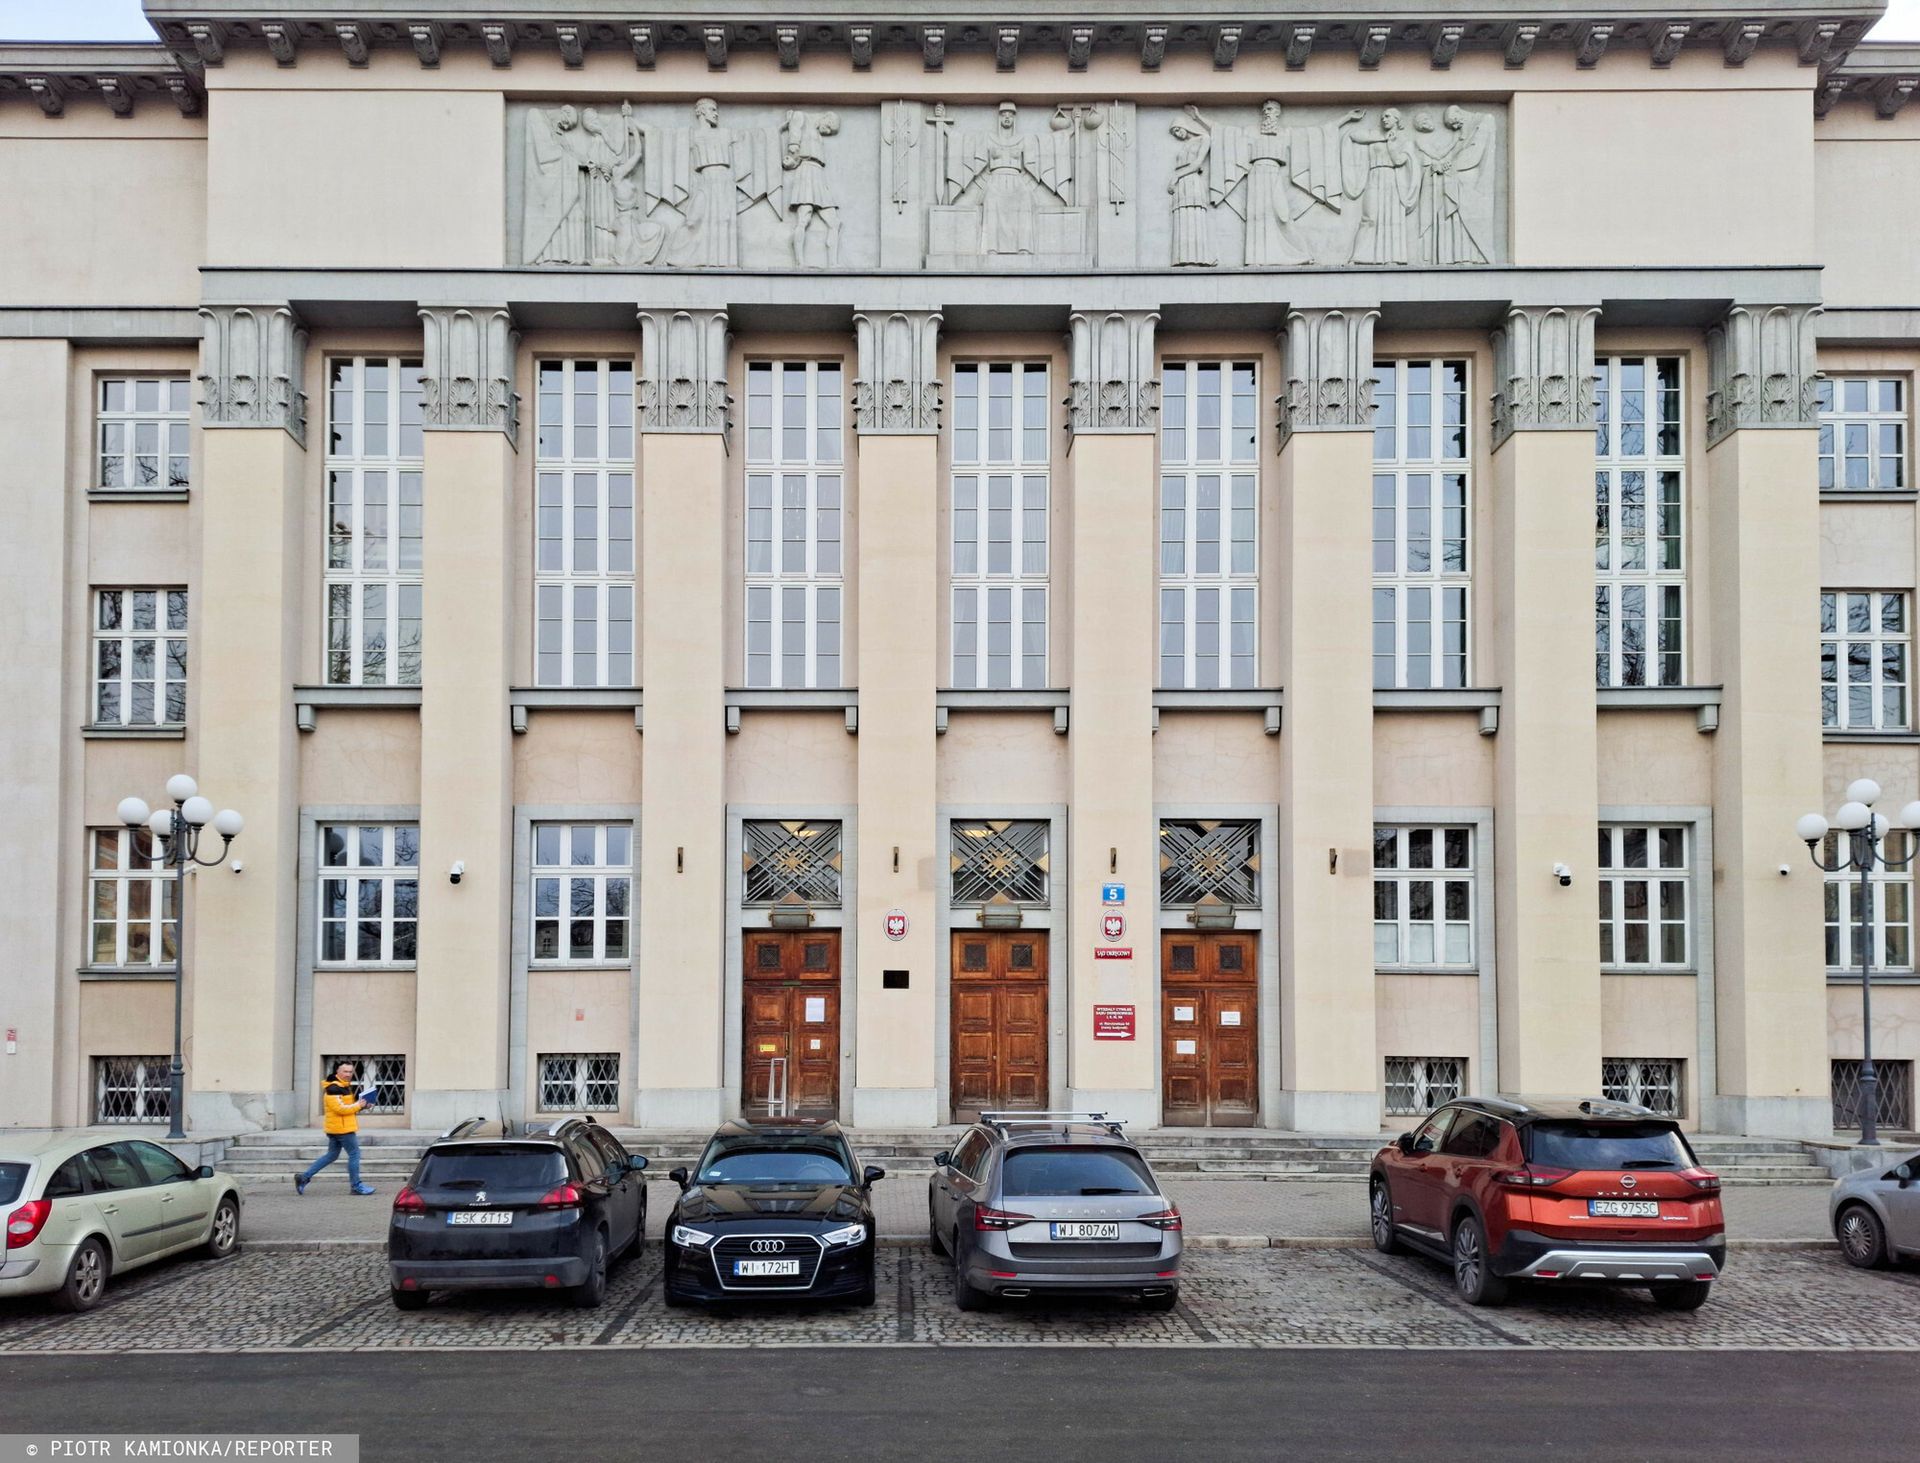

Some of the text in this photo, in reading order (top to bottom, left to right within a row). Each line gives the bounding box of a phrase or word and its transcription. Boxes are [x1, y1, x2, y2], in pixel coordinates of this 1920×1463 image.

[1109, 888, 1118, 900] 5
[1595, 1202, 1657, 1214] EZG 9755C
[454, 1212, 510, 1223] ESK 6T15
[1059, 1224, 1116, 1236] WJ 8076M
[742, 1261, 796, 1273] WI 172HT
